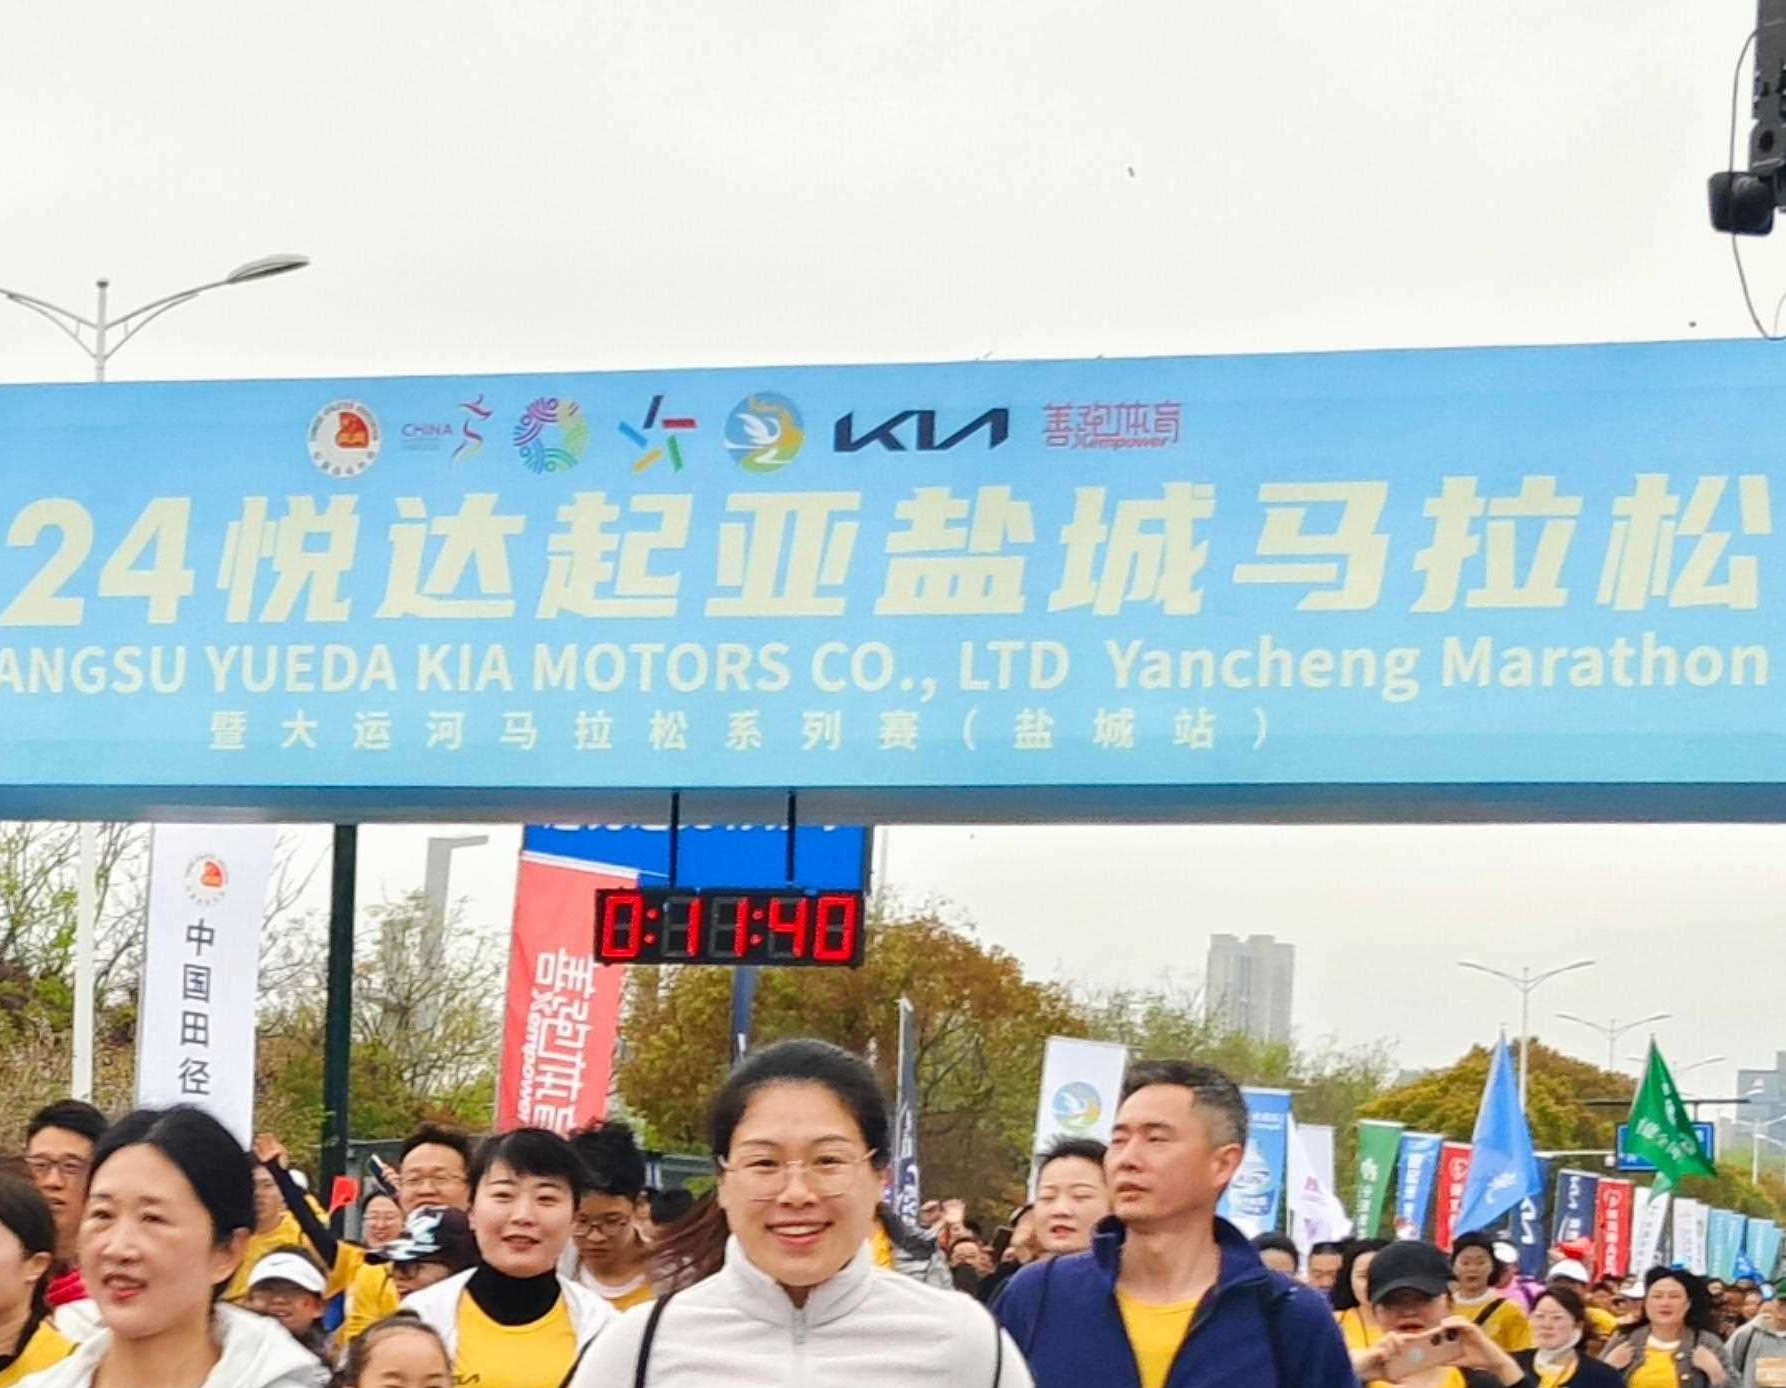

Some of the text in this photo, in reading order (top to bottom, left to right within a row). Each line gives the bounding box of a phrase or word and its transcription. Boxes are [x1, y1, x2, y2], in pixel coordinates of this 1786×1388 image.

[400, 422, 454, 438] CHINA
[206, 645, 398, 694] YUEDA
[417, 645, 516, 692] KIA
[533, 642, 792, 694] MOTORS
[960, 640, 1072, 692] LTD
[1108, 634, 1422, 701] Yancheng
[1442, 631, 1772, 690] Marathon
[600, 893, 860, 964] 0:11:40
[177, 917, 215, 1096] 中国田径
